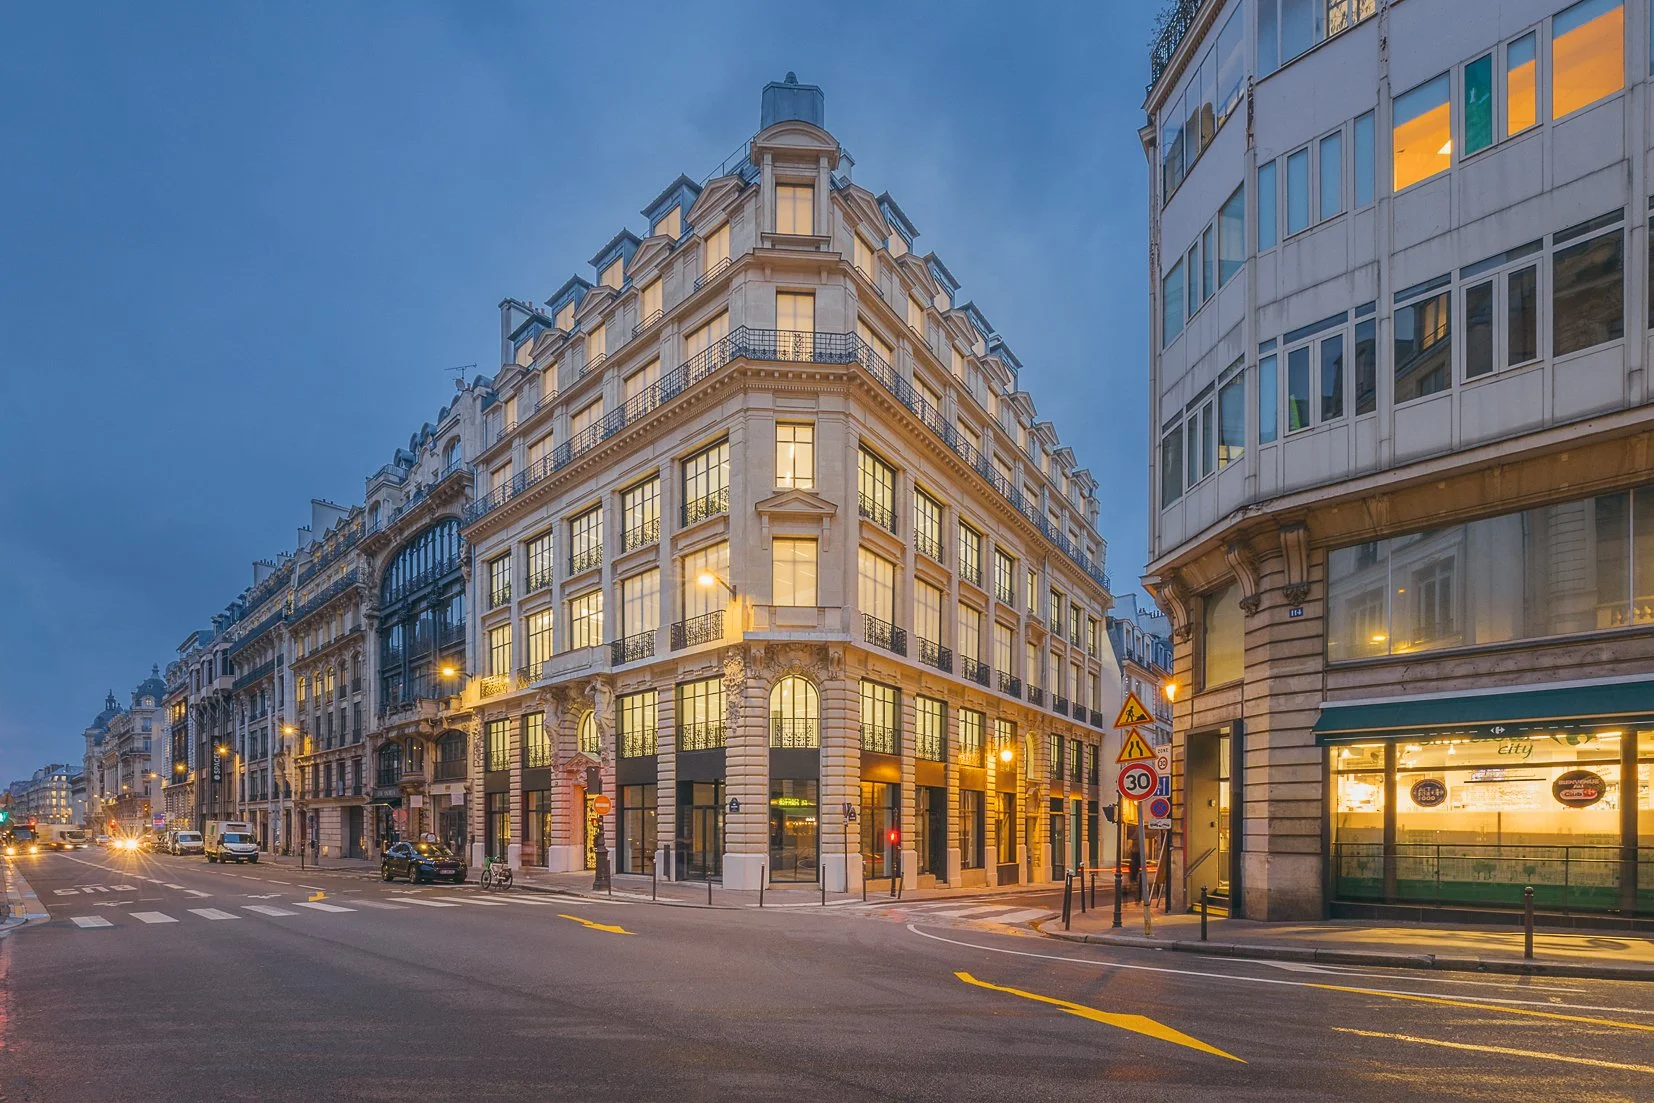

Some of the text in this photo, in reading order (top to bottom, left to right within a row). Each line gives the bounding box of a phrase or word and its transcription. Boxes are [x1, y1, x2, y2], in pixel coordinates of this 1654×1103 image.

[1498, 743, 1533, 759] city
[1126, 773, 1150, 791] 30
[52, 884, 138, 896] BUS
